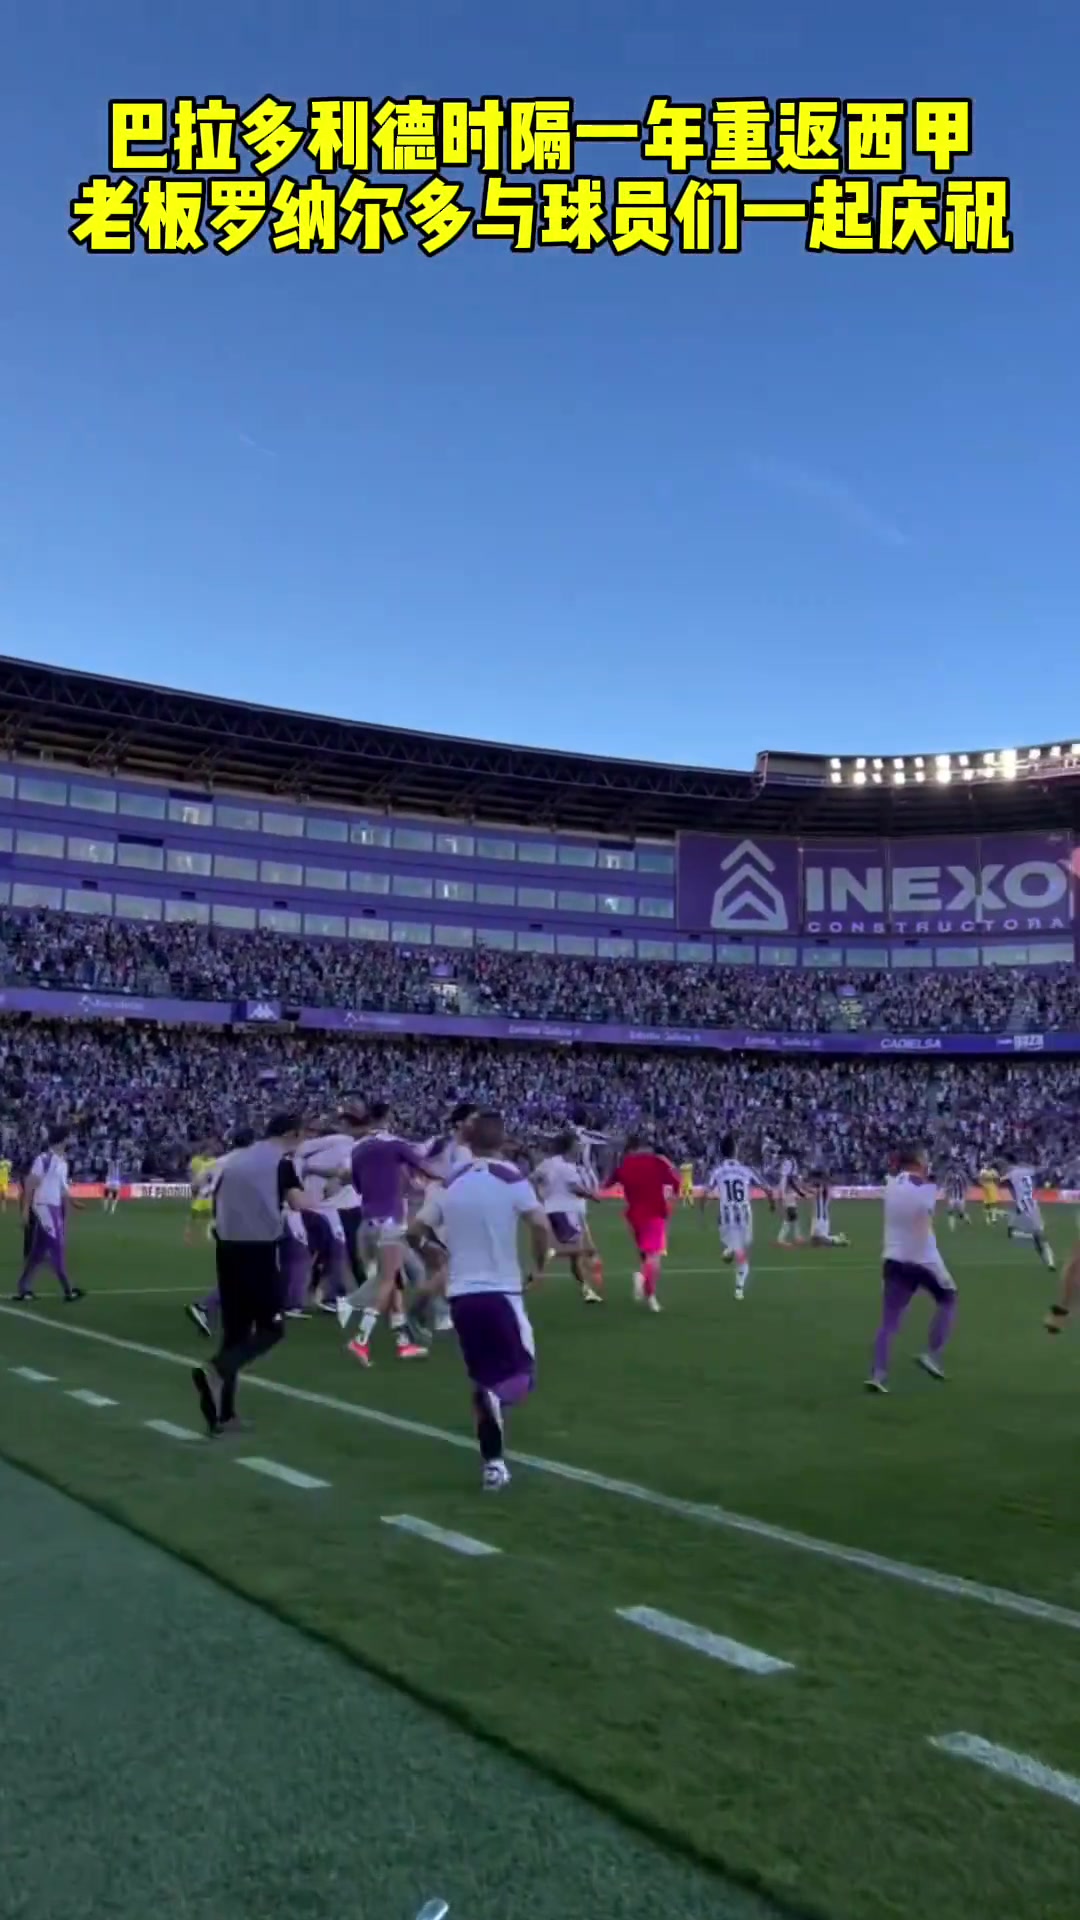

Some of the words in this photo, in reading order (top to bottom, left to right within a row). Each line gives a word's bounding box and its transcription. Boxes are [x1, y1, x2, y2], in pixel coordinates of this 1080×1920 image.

[805, 861, 1067, 913] INEXO
[807, 918, 1064, 934] CONSTRUCTORA
[724, 1179, 745, 1202] 16
